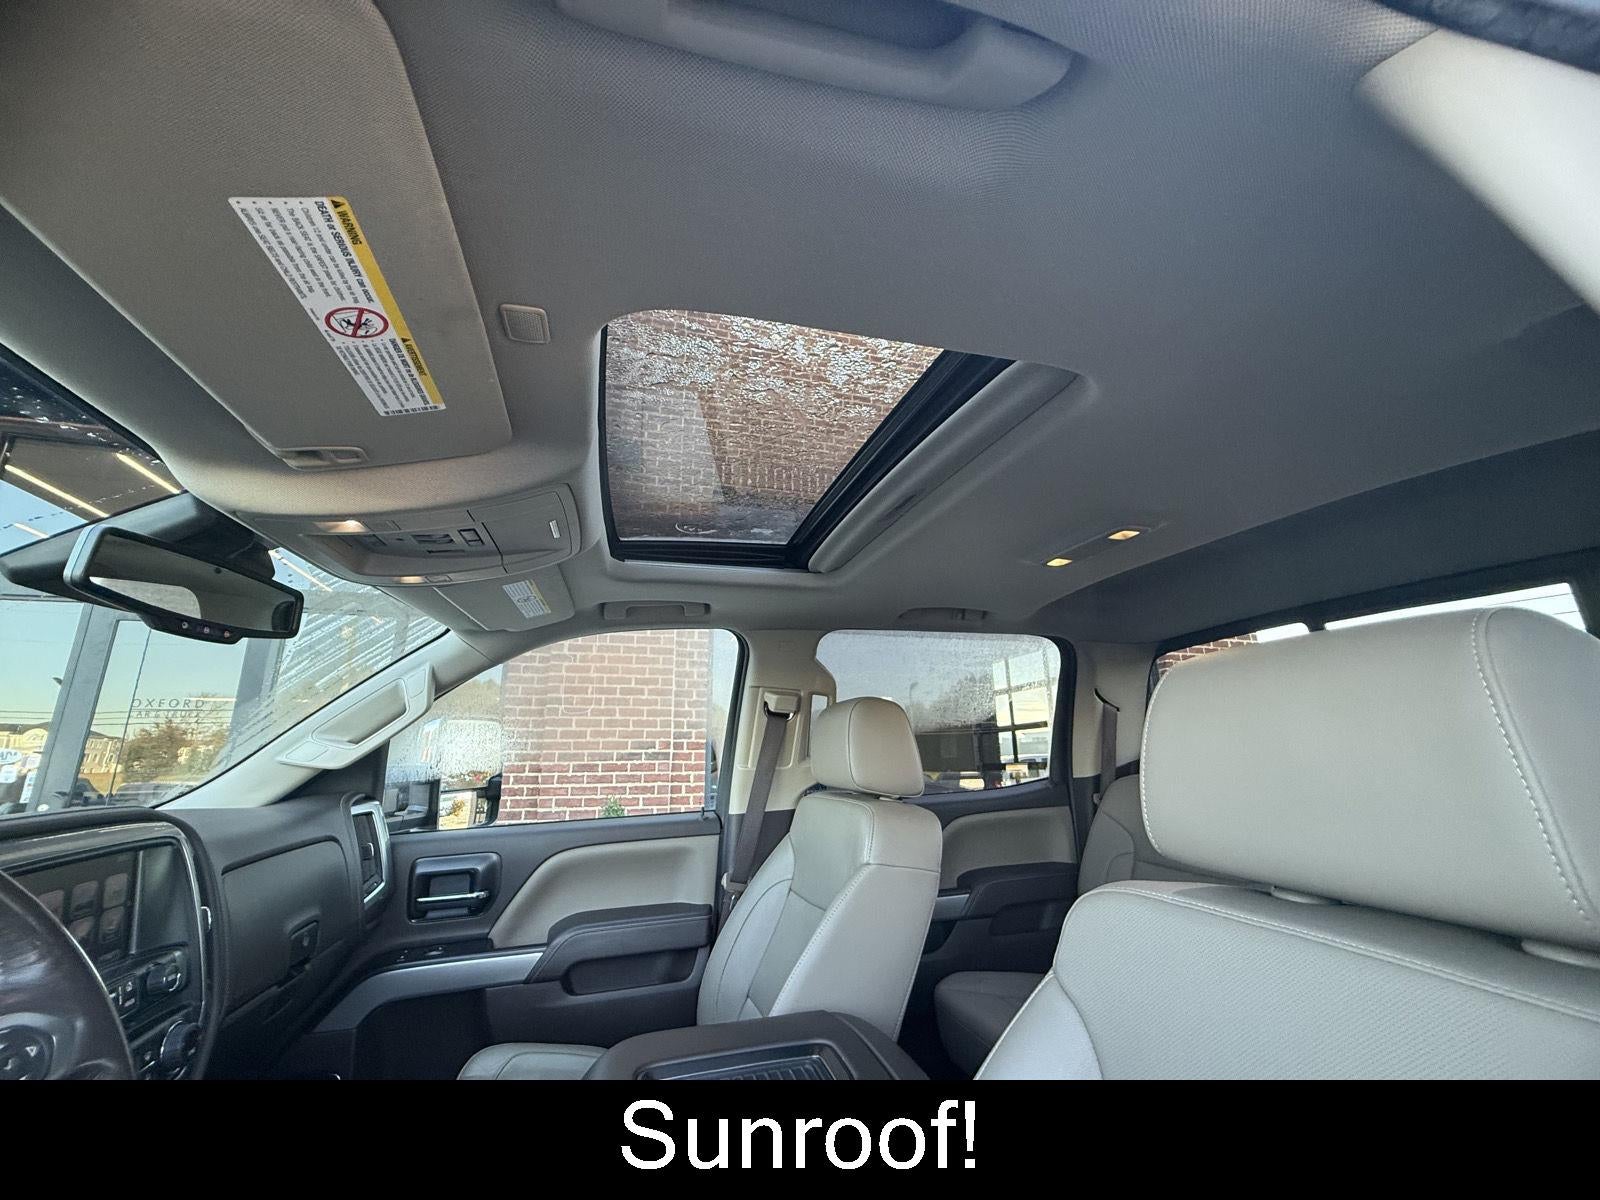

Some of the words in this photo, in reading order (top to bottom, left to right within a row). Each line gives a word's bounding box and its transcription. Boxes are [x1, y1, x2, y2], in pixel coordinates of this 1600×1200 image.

[315, 201, 334, 222] DEATH
[332, 231, 352, 256] SERIOUS
[346, 257, 362, 277] INJURY
[337, 210, 362, 244] WARNING
[132, 698, 205, 709] OXFORD
